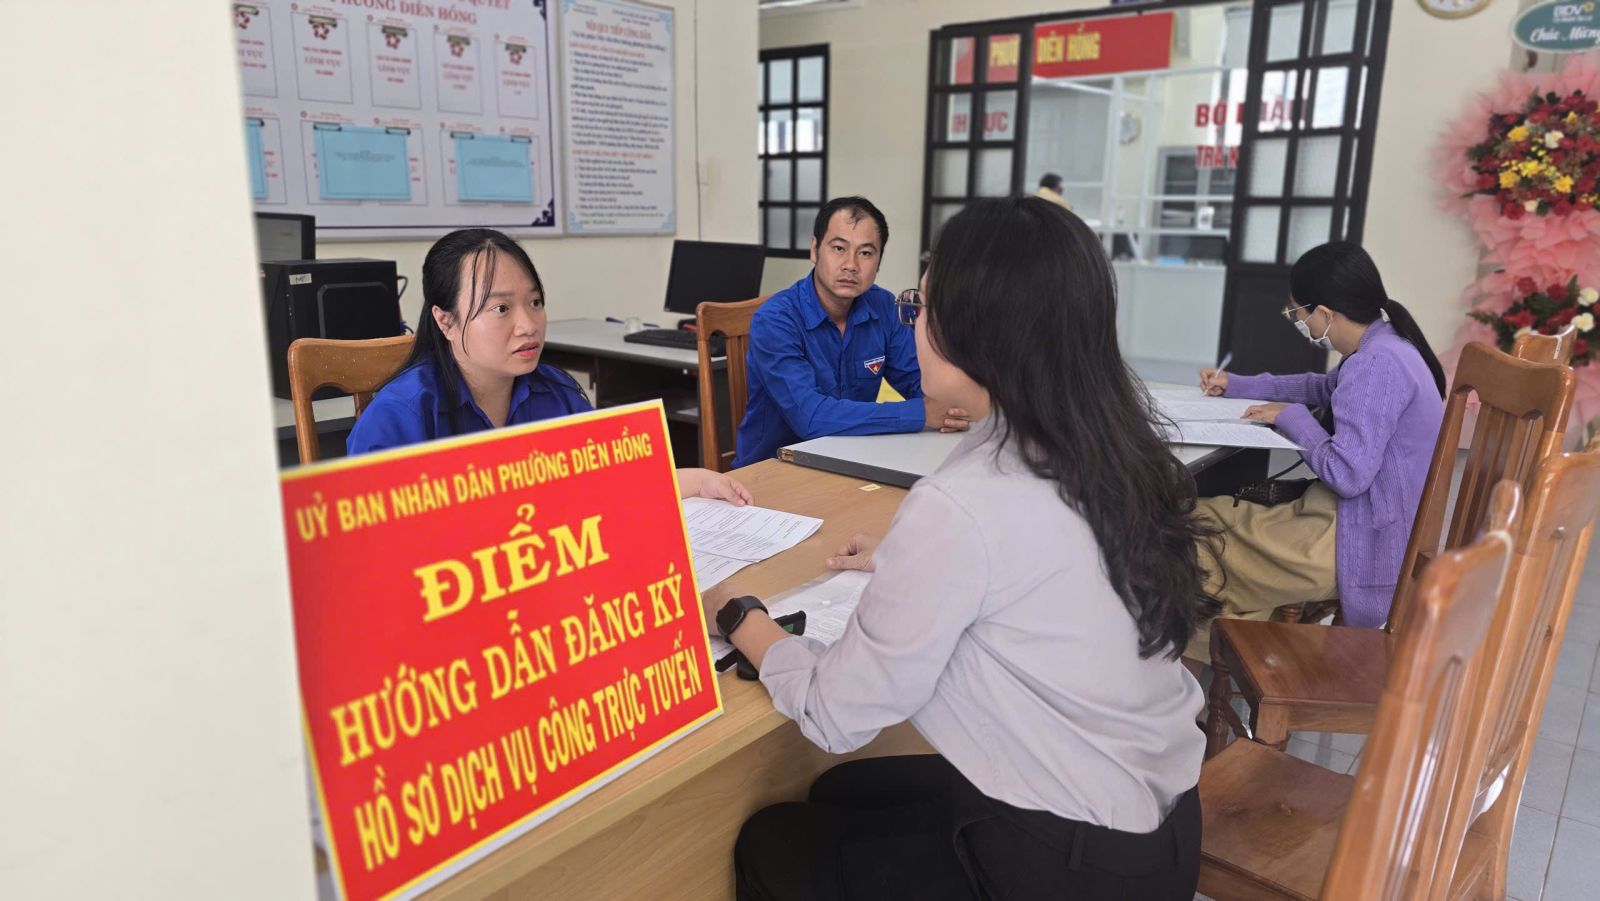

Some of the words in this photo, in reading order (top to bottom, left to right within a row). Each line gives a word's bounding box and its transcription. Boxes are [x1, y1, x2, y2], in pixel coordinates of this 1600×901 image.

[400, 4, 435, 17] DIÊN
[439, 8, 477, 25] HỒNG
[1036, 31, 1065, 64] DIÊN
[1066, 23, 1102, 61] HỒNG
[1195, 97, 1228, 133] BỘ
[295, 491, 328, 541] UỶ
[337, 490, 387, 532] BAN
[390, 473, 450, 519] NHÂN
[453, 464, 495, 503] DÂN
[497, 449, 570, 492] PHƯỜNG
[571, 438, 610, 474] DIÊN
[611, 426, 653, 464] HỒNG
[413, 503, 609, 623] ĐIỂM
[330, 662, 478, 767] HƯỚNG
[483, 609, 557, 700] DẪN
[560, 593, 645, 666] ĐĂNG
[647, 562, 685, 628] KÝ
[354, 764, 400, 872] HỒ
[401, 762, 440, 845] SƠ
[440, 742, 504, 830] DỊCH
[501, 725, 538, 795] VỤ
[538, 696, 597, 773] CÔNG
[592, 667, 646, 742] TRỰC
[643, 630, 703, 716] TUYẾN
